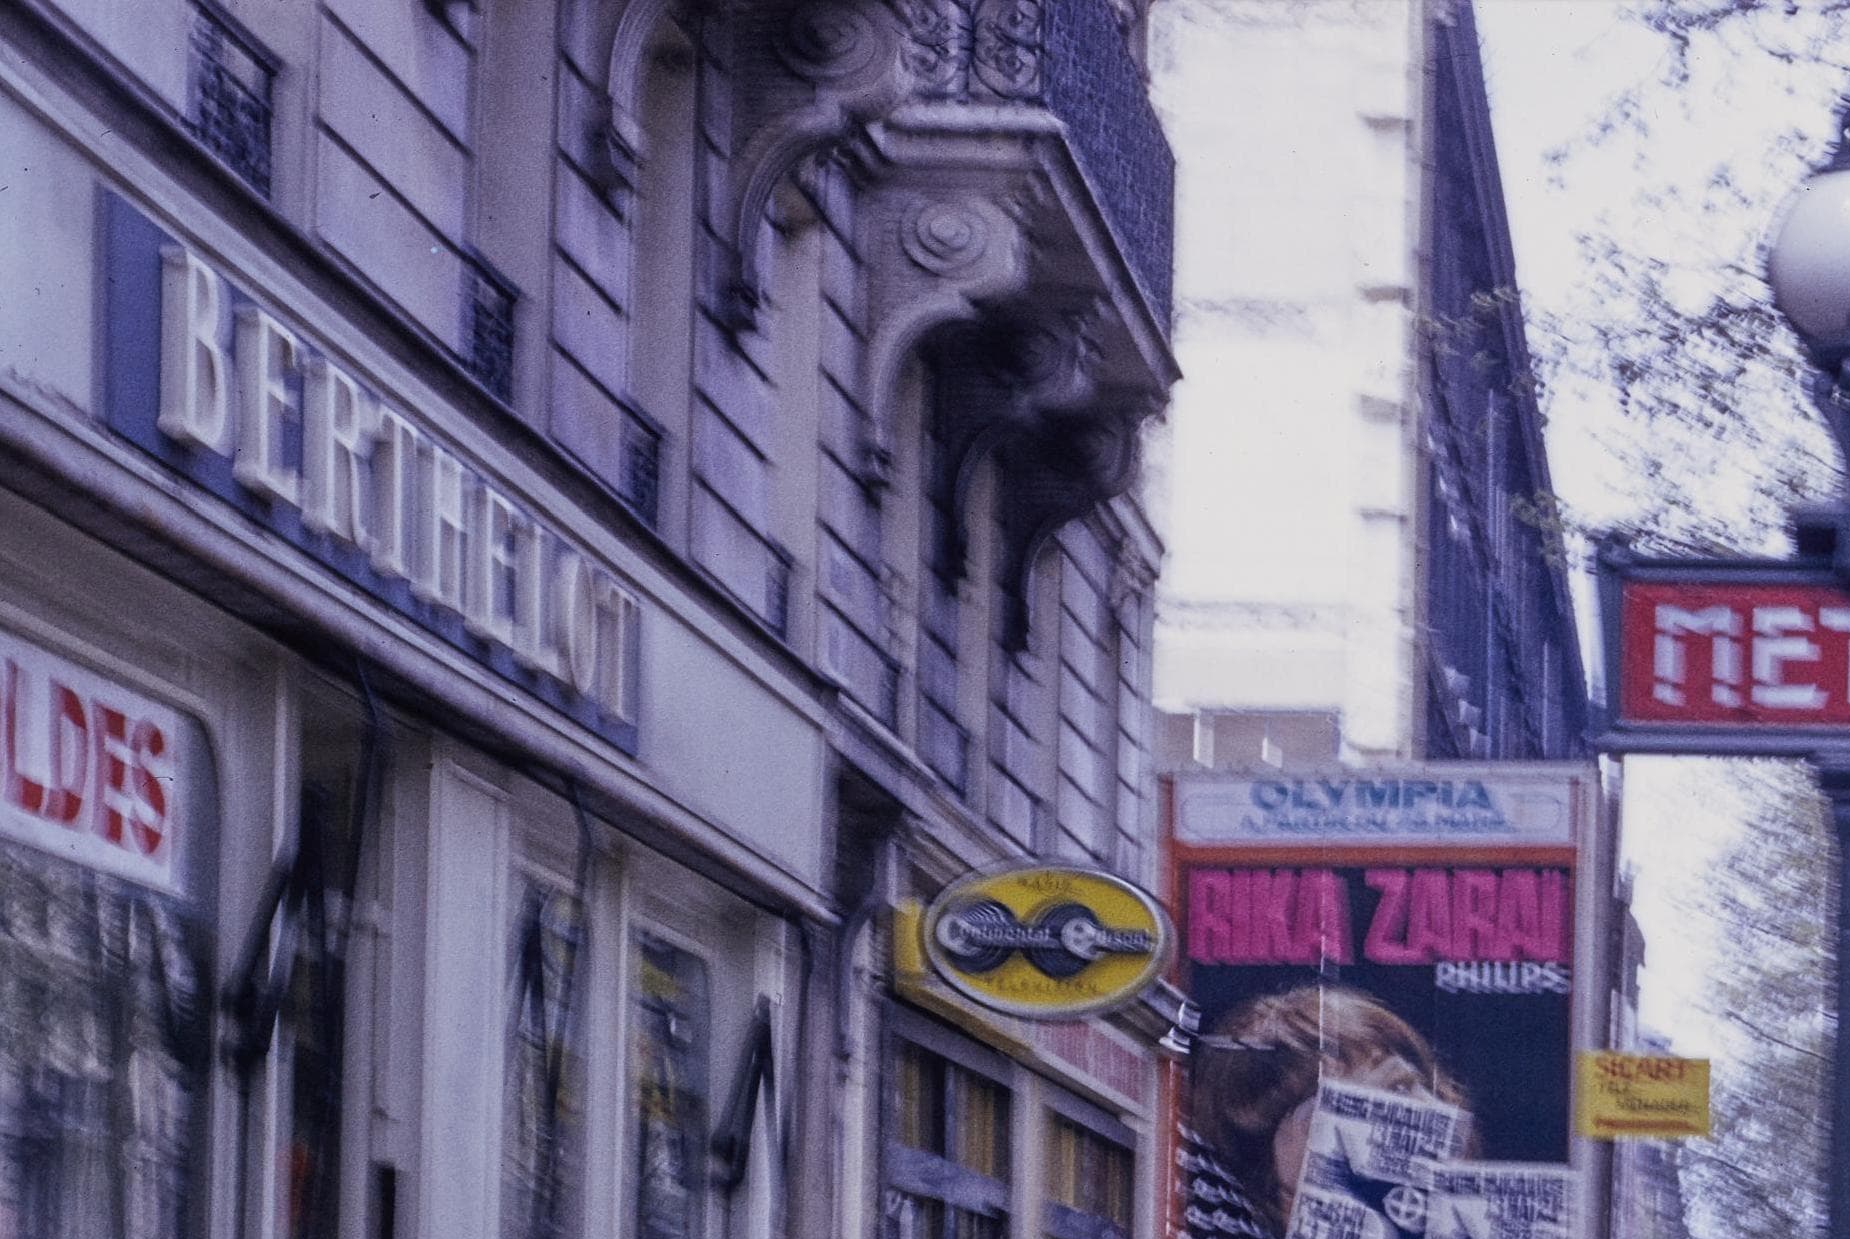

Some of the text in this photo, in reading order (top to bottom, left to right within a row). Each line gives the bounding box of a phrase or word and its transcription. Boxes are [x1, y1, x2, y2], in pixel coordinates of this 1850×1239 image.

[1250, 780, 1495, 811] OLYMPIA
[1188, 868, 1352, 965] RIKA
[1436, 961, 1571, 993] PHILIPS
